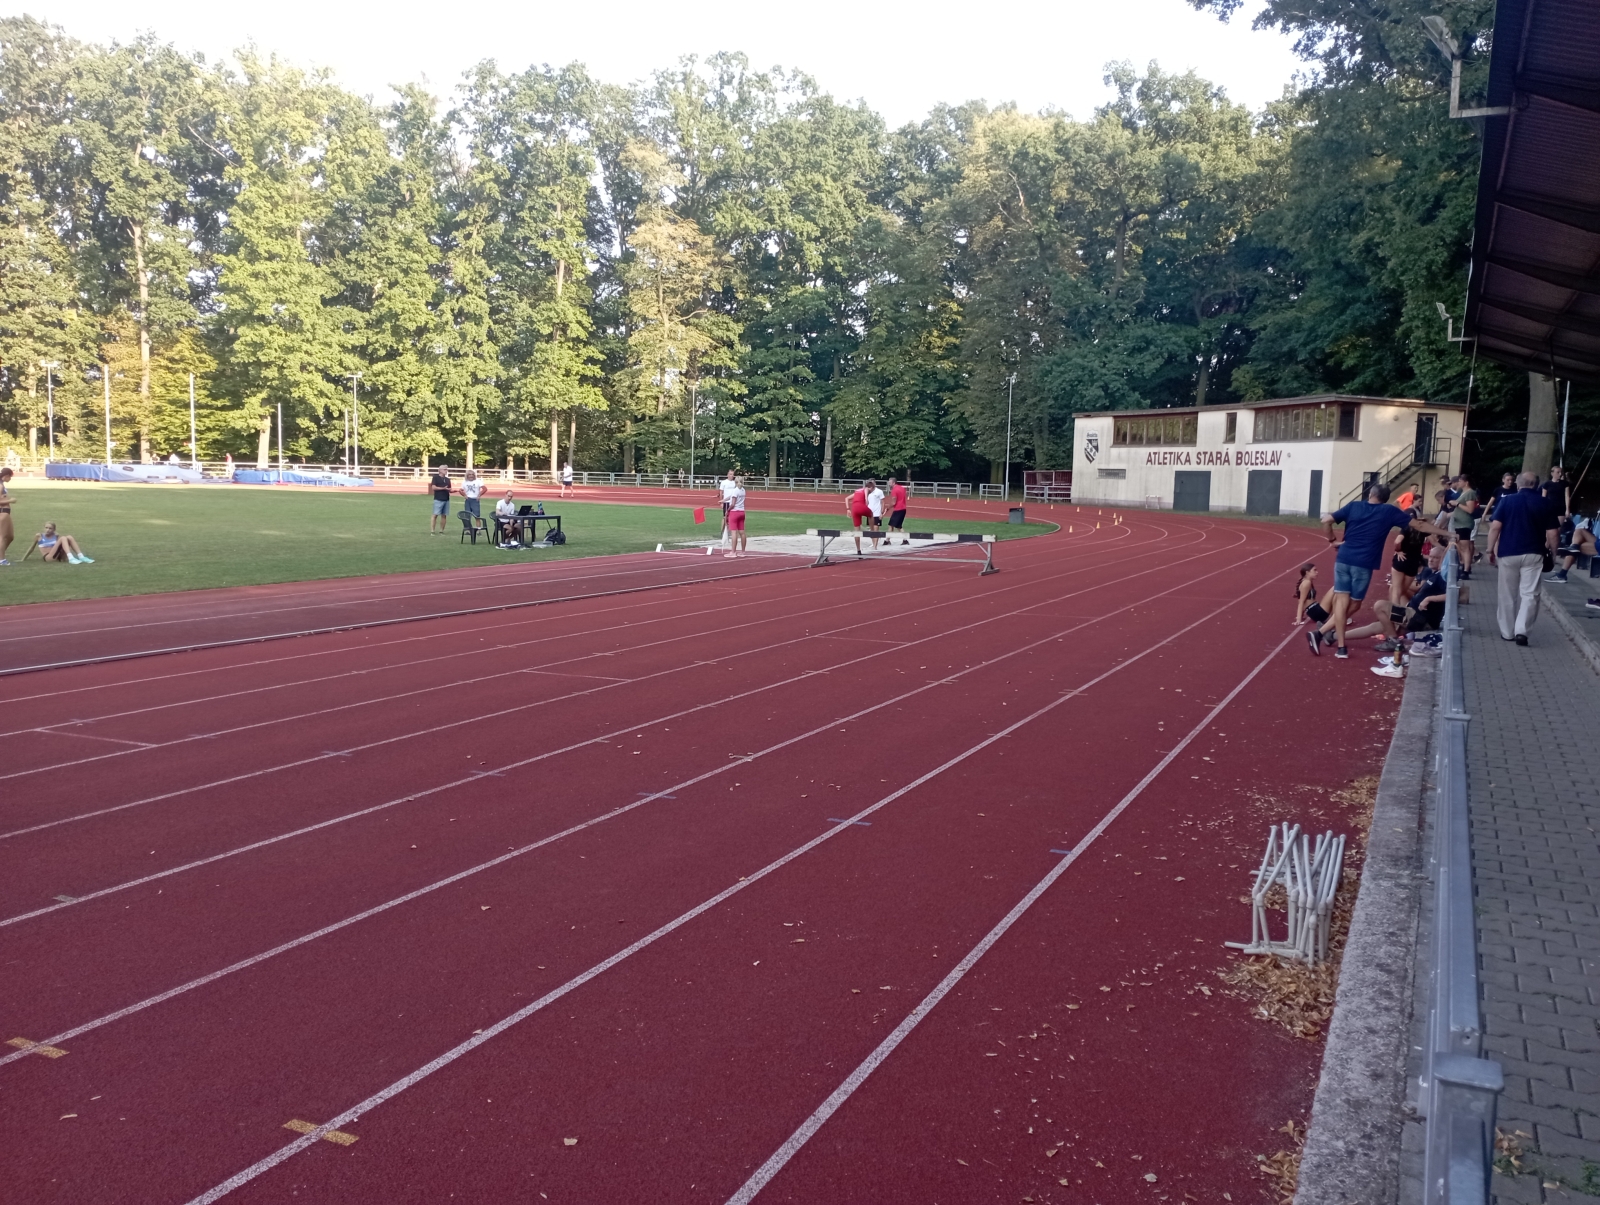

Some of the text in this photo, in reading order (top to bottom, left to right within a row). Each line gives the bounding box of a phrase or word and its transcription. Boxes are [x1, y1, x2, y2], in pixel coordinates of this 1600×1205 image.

[1146, 448, 1282, 466] ATLETIKA STARÁ BOLESLAV
